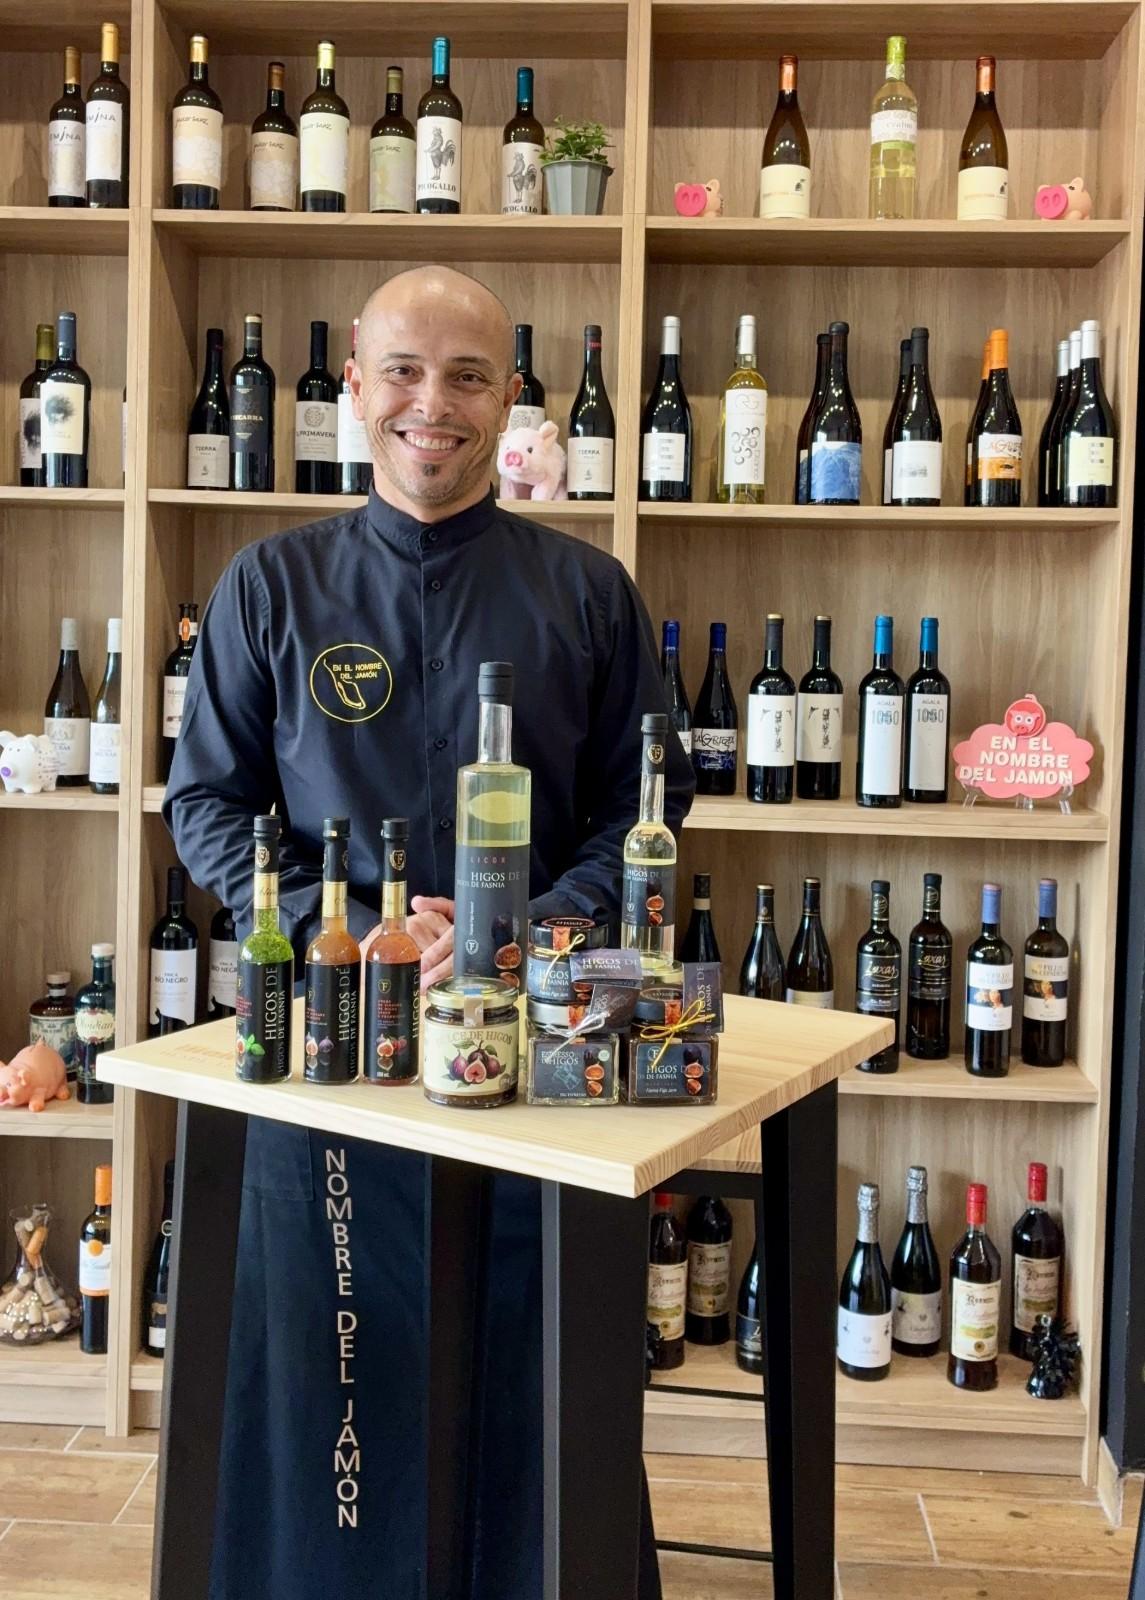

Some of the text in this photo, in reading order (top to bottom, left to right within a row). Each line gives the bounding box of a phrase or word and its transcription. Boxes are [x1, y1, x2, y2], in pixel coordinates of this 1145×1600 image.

[355, 663, 382, 671] NOMBRE
[989, 735, 1054, 752] EN EL
[979, 750, 1070, 769] NOMBRE
[959, 765, 1074, 785] DEL JAMON
[471, 871, 520, 882] HIGOS DE
[627, 868, 648, 878] HIGOS
[481, 881, 505, 889] FASNIA
[582, 957, 621, 965] HIGOS
[265, 967, 278, 1040] HIGOS DE
[278, 989, 287, 1025] FASNIA
[339, 967, 351, 1041] HIGOS DE
[469, 1031, 484, 1040] DE
[485, 1031, 513, 1045] HIGOS
[646, 1065, 678, 1074] HIGOS
[325, 1148, 361, 1528] NOMBRE DEL JAMÓN
